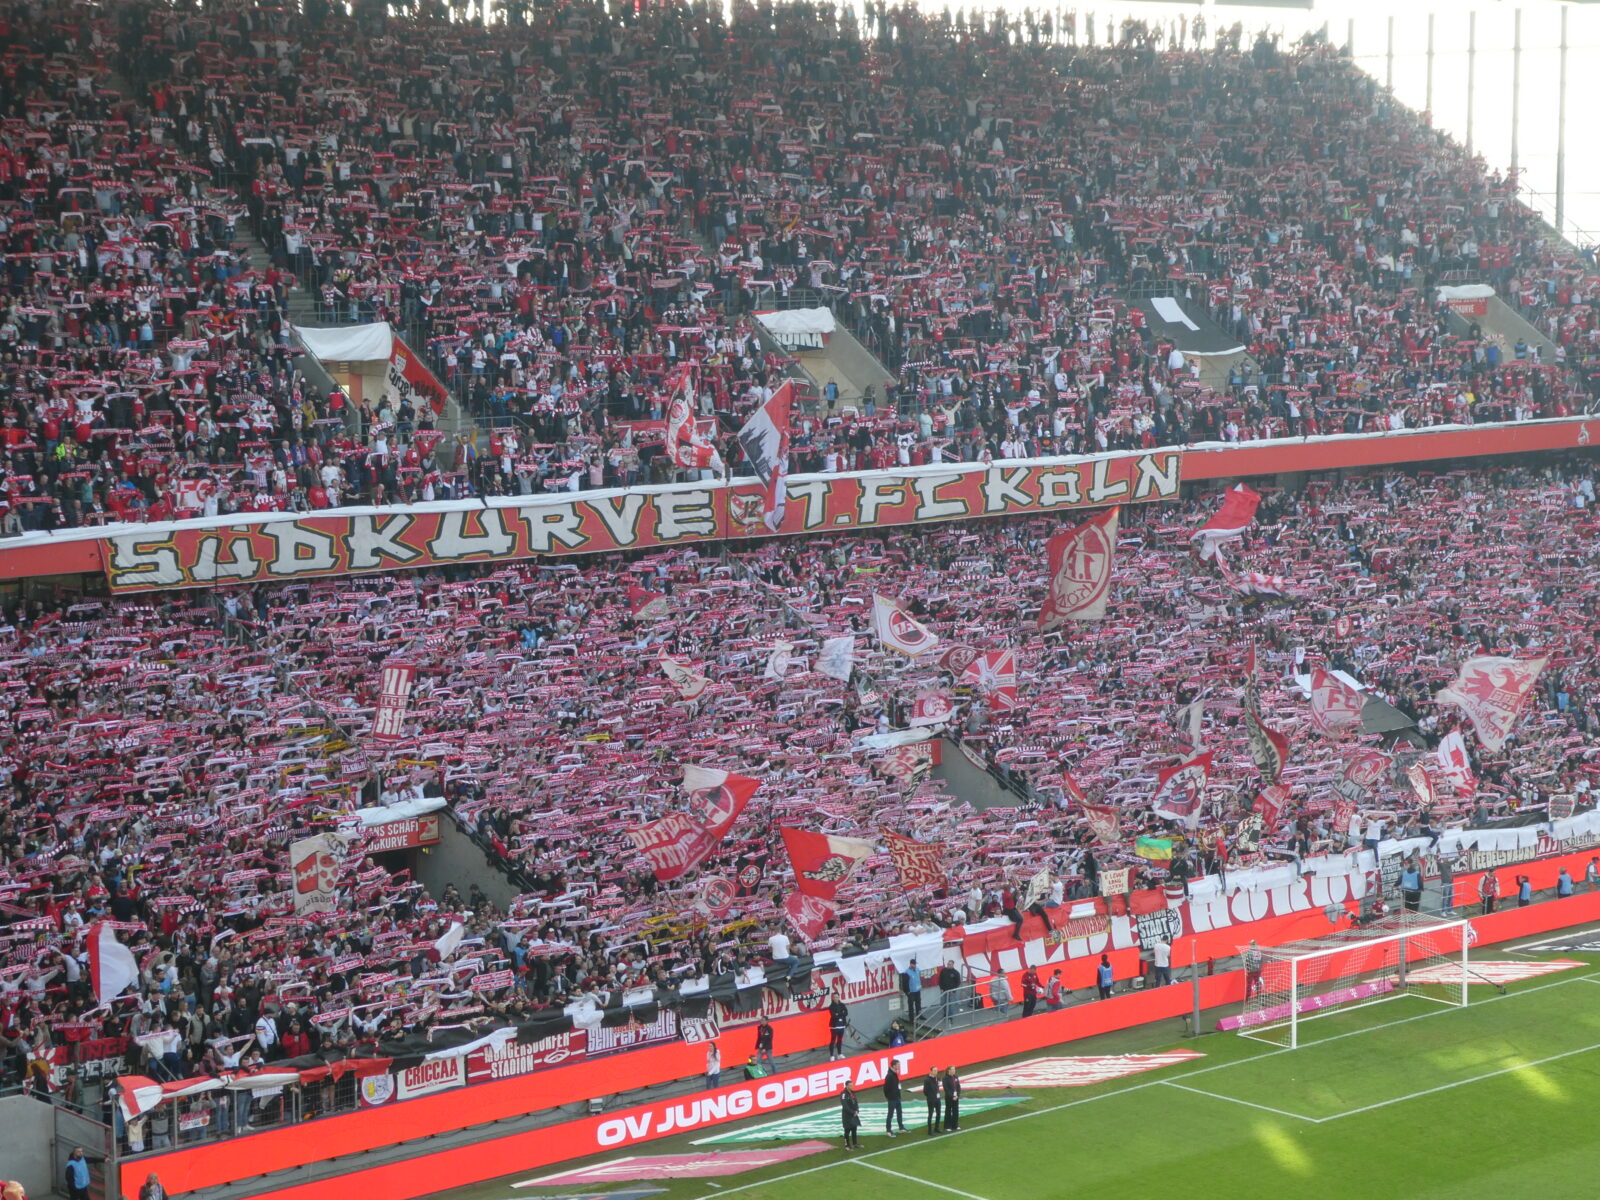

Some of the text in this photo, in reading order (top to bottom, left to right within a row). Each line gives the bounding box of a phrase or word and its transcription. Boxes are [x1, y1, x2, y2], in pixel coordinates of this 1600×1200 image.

[110, 488, 716, 587] SÜDKURVE
[982, 453, 1181, 514] KÖLN
[1139, 918, 1169, 939] STADT
[491, 1054, 533, 1078] STADION
[596, 1111, 653, 1147] OV
[656, 1090, 752, 1133] JUNG
[756, 1066, 852, 1109] ODER
[855, 1052, 914, 1085] ALT
